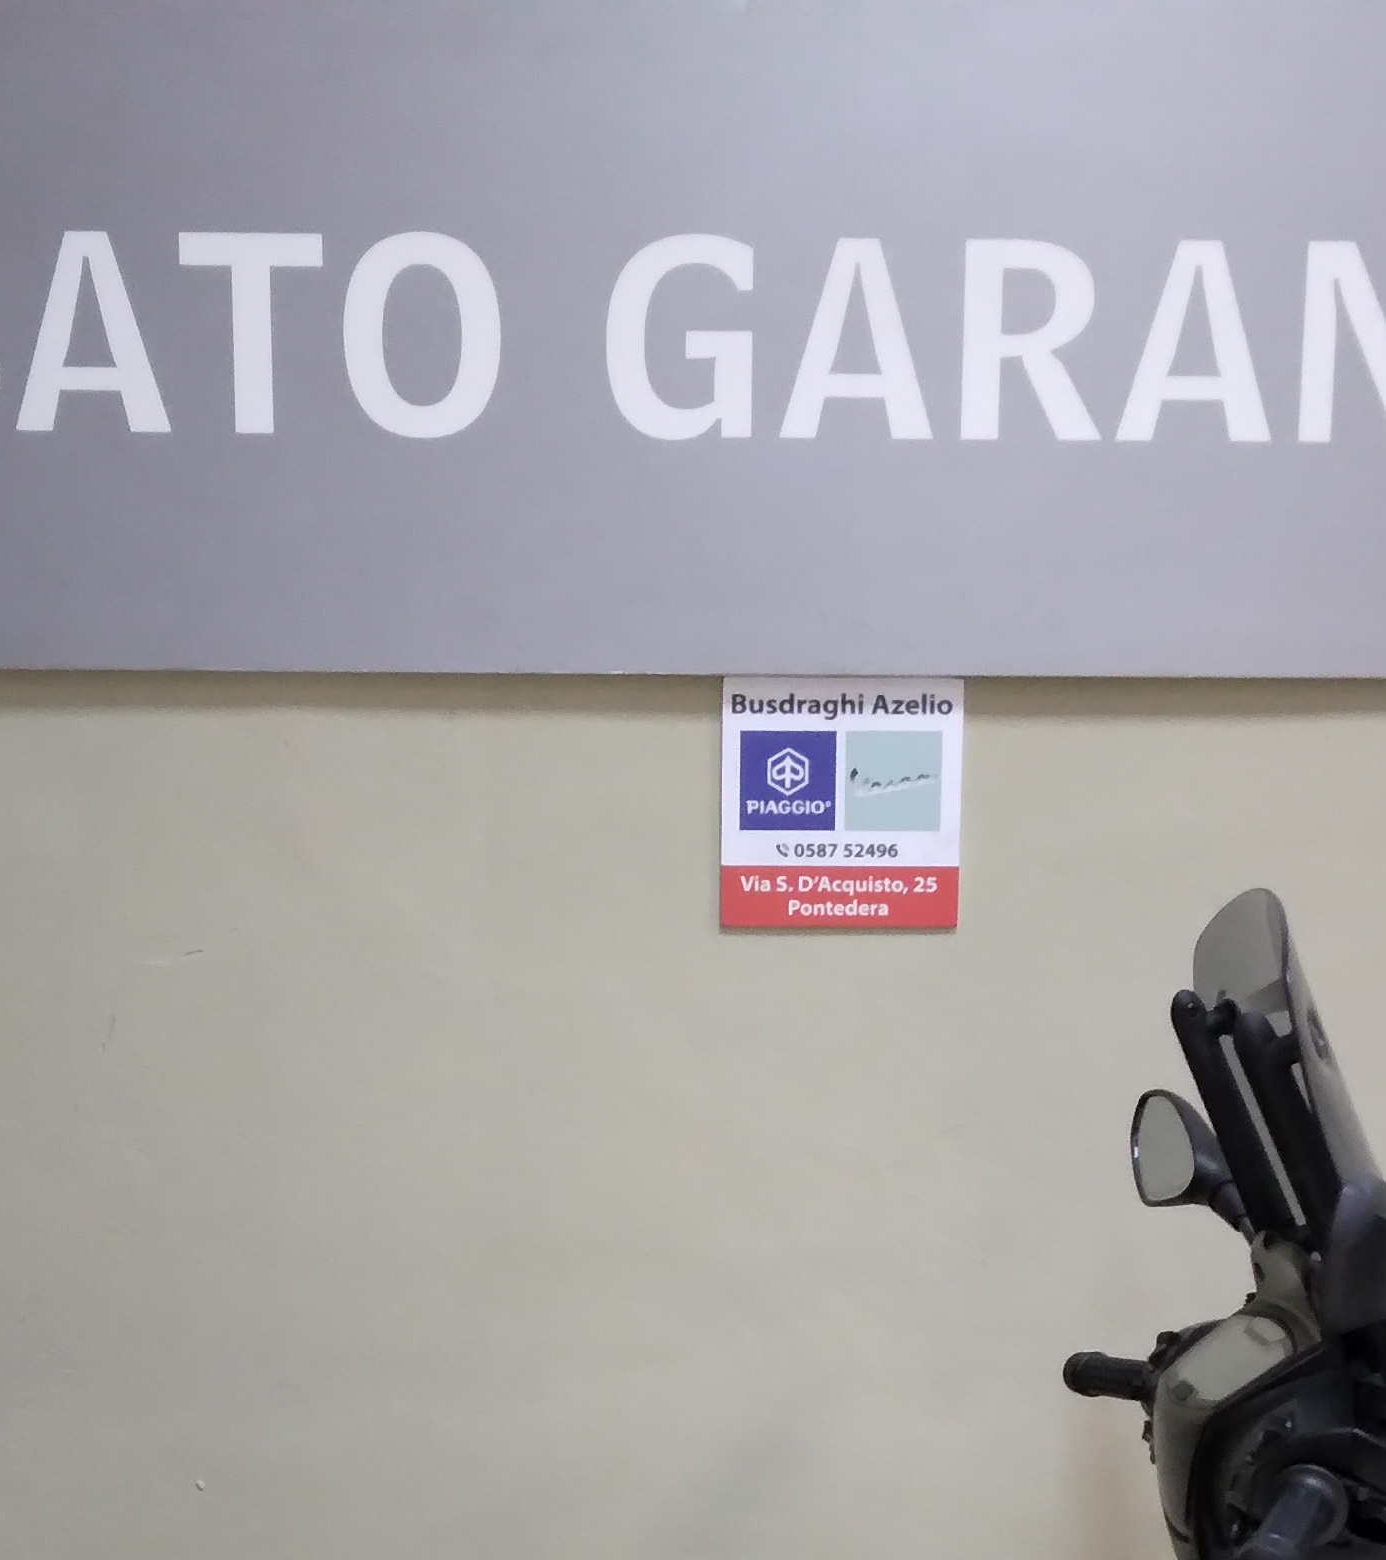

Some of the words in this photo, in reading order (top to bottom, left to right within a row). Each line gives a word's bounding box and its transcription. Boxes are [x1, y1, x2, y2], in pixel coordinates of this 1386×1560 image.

[731, 693, 864, 720] Busdraghi
[872, 694, 953, 716] Azelio
[746, 800, 825, 815] PIAGGIO
[794, 843, 838, 858] 0587
[843, 843, 899, 858] 52496
[740, 875, 771, 893] Via
[776, 876, 793, 893] S.
[798, 876, 908, 896] D'Acquisto,
[913, 877, 938, 893] 25
[788, 899, 889, 916] Pontedera
